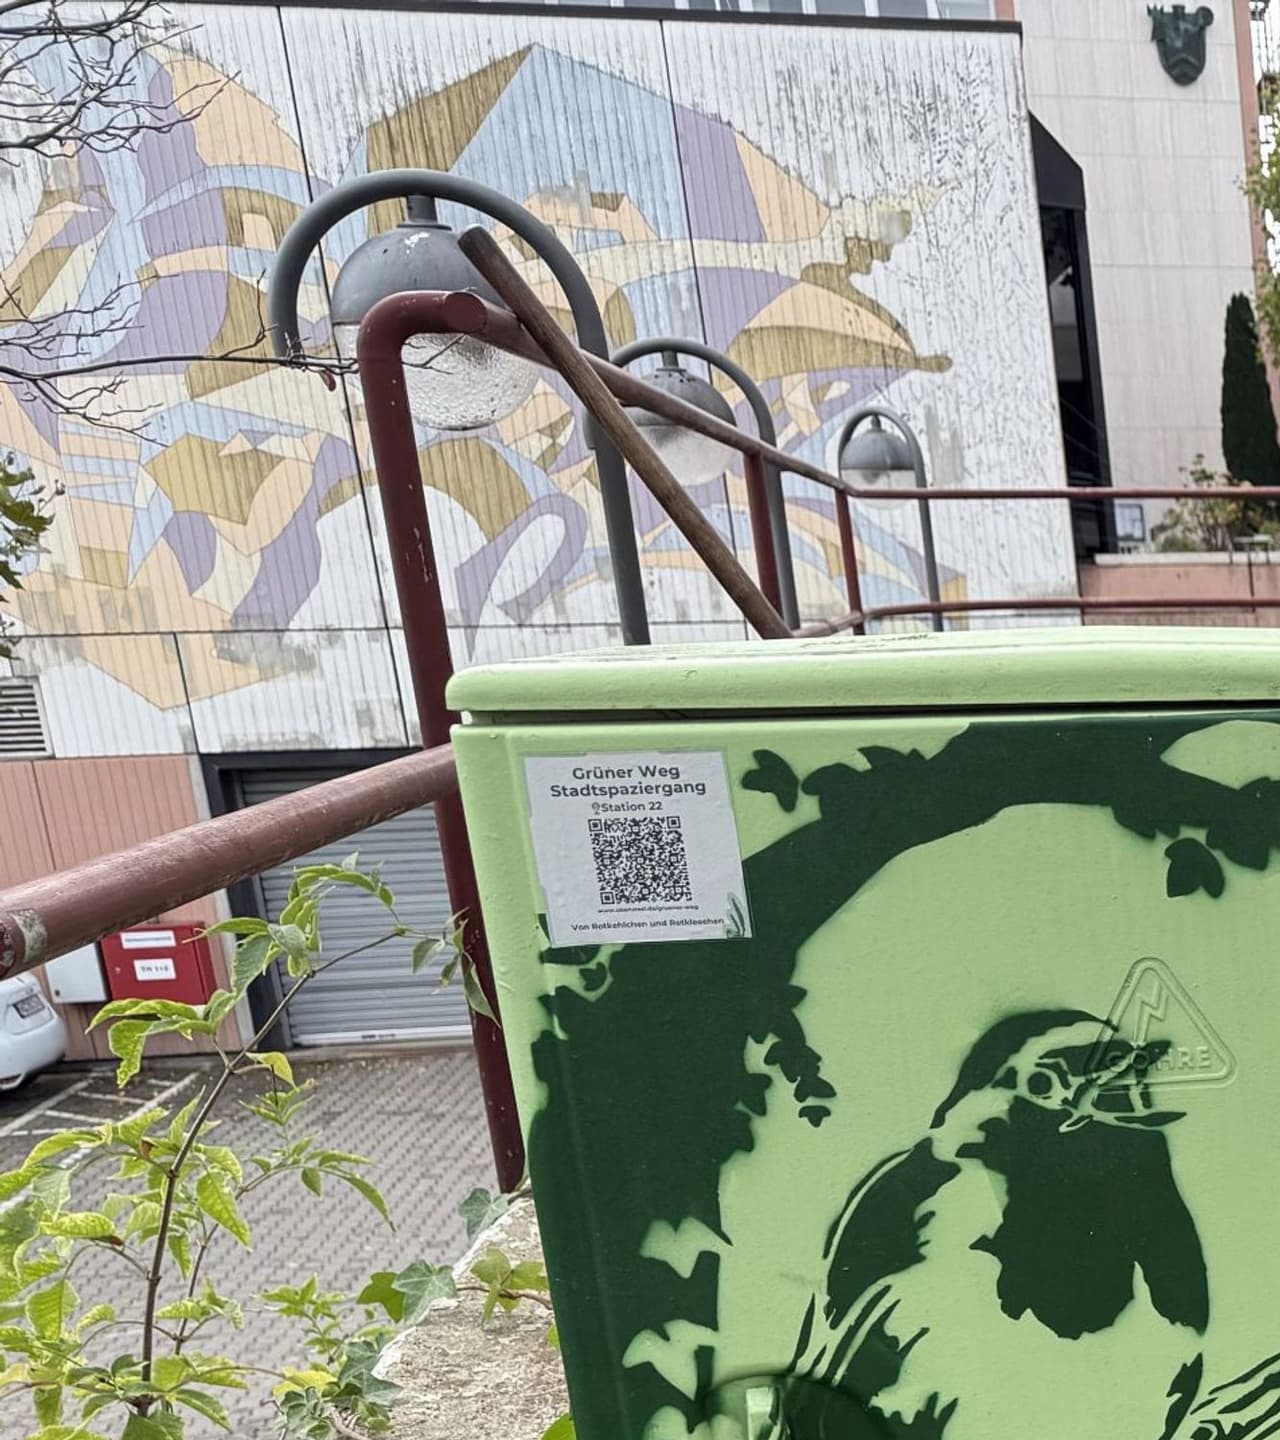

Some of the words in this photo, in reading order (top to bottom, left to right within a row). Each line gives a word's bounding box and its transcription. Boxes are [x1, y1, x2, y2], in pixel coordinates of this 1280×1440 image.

[572, 766, 633, 780] Grüner
[639, 765, 681, 780] Weg
[550, 780, 707, 799] Stadtspaziergang
[601, 801, 646, 813] Station
[648, 801, 663, 812] 22
[571, 923, 590, 931] Von
[650, 919, 667, 928] und
